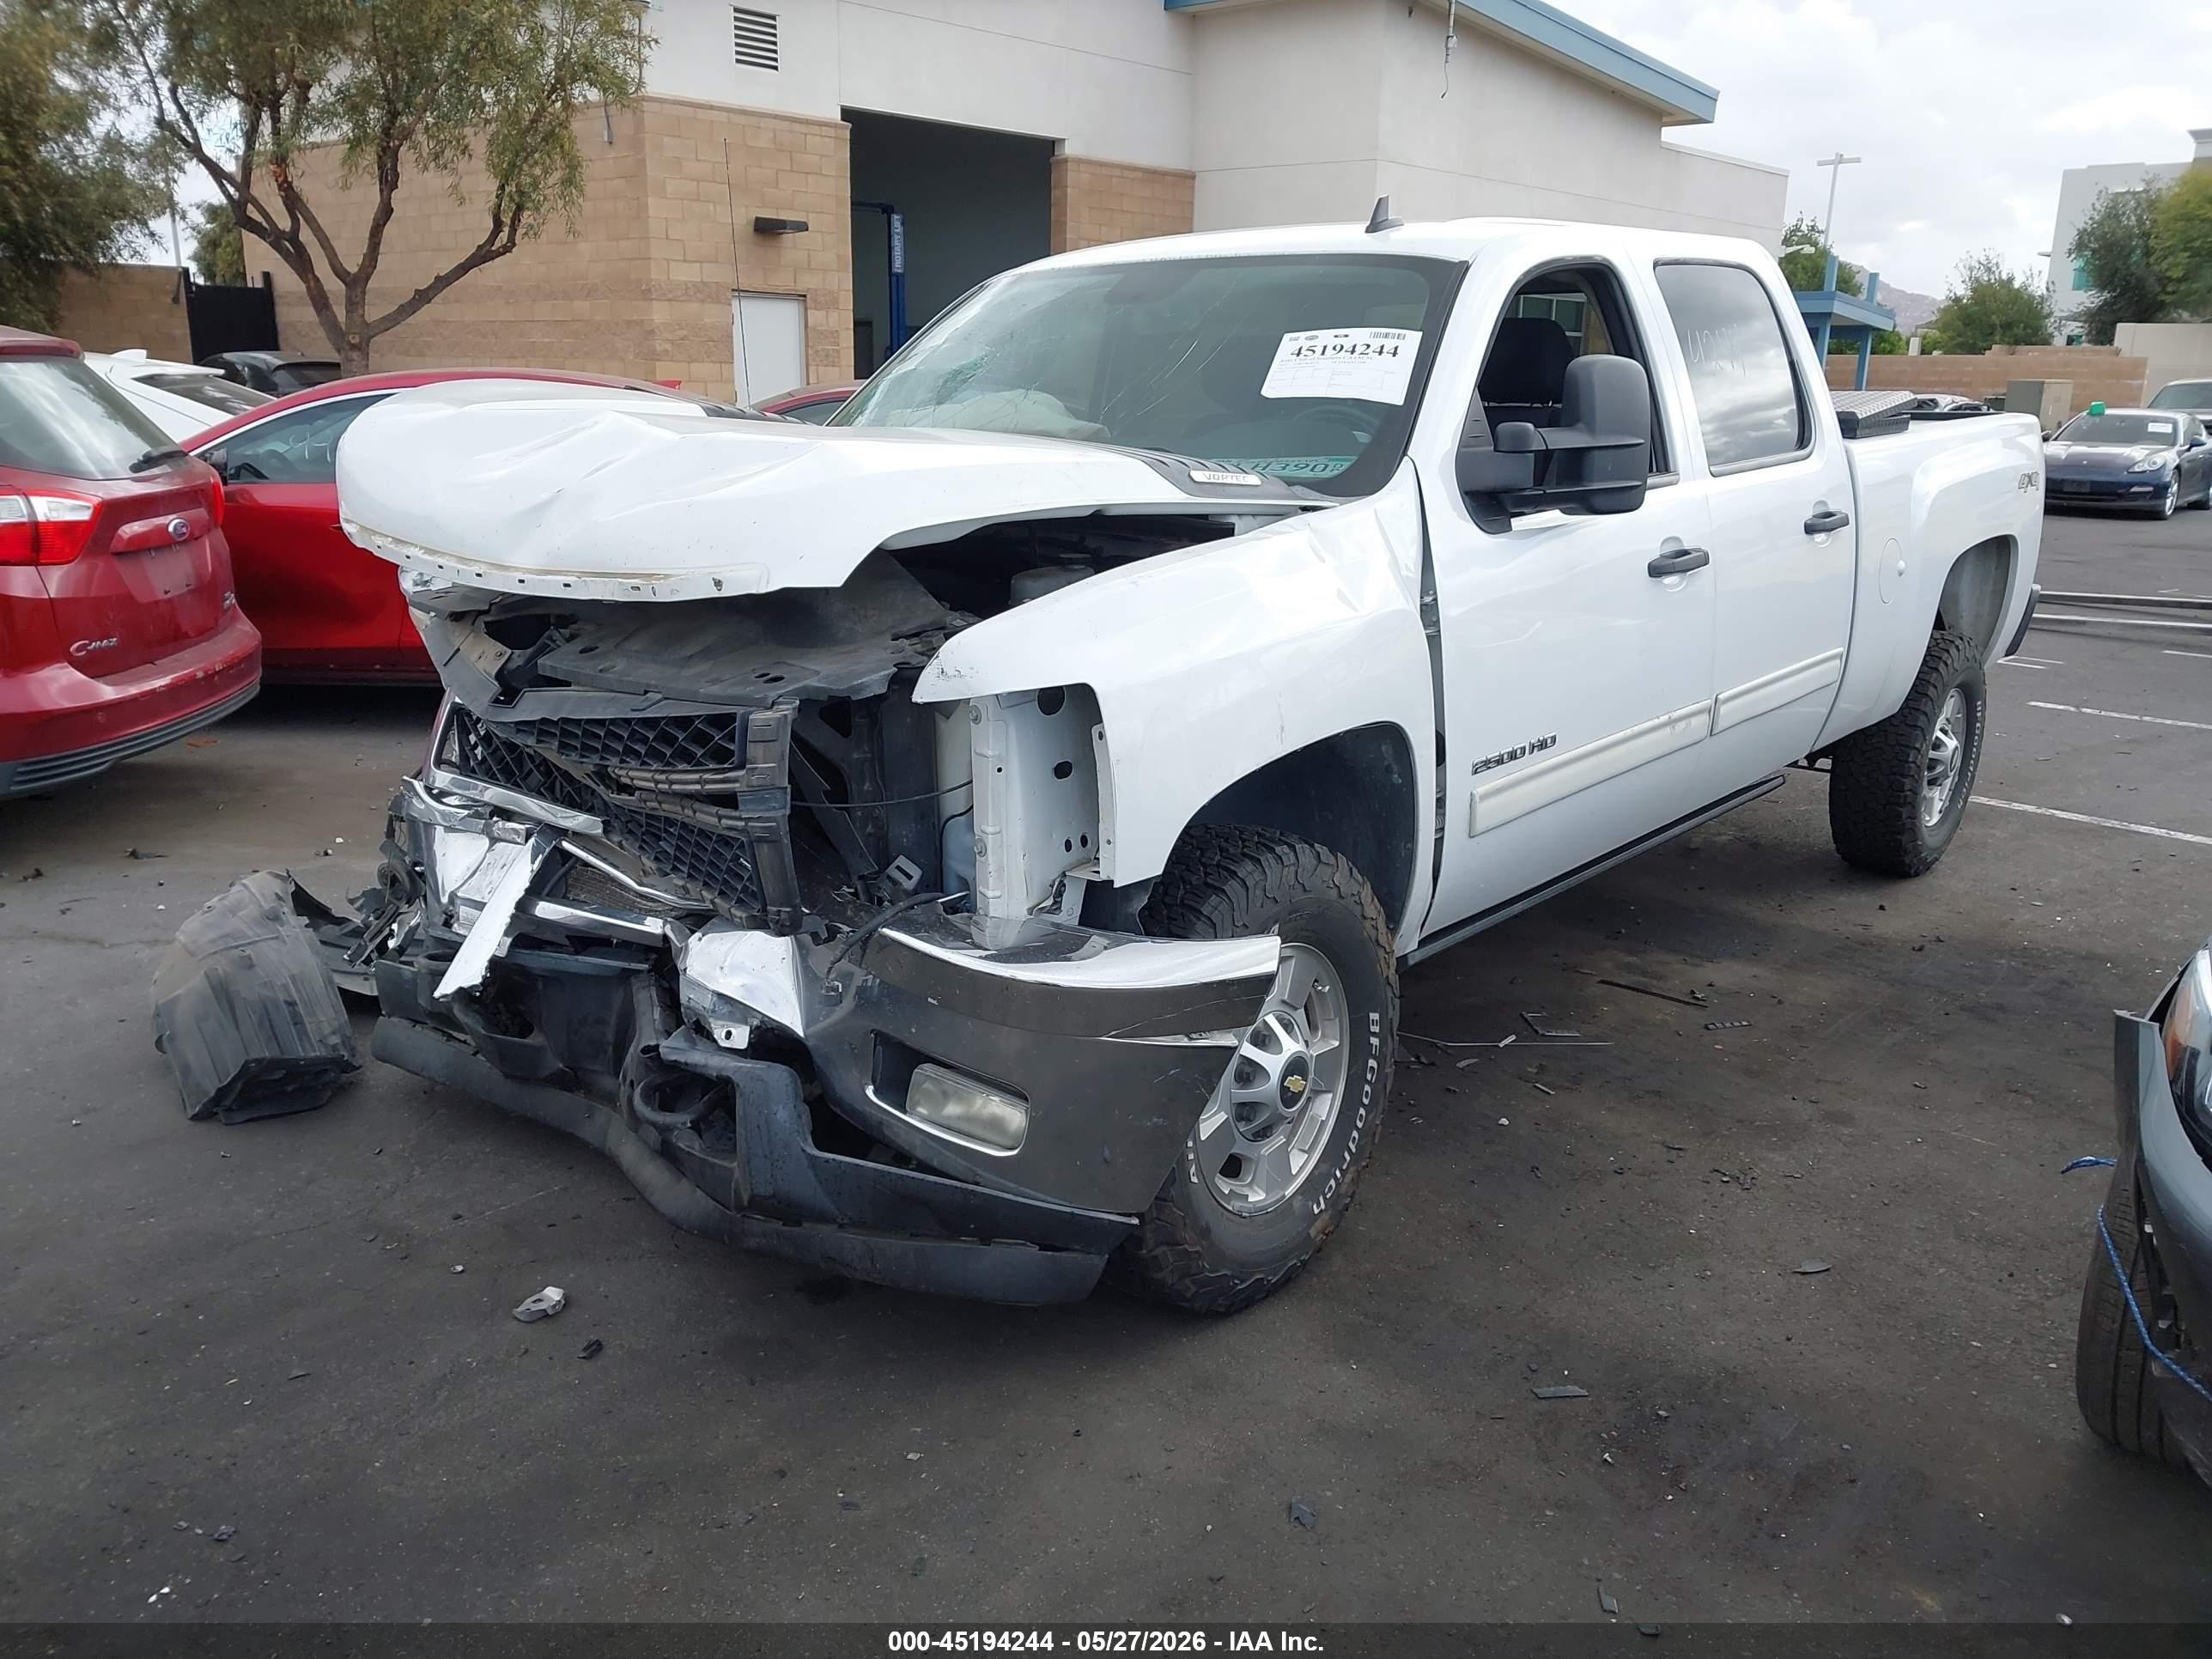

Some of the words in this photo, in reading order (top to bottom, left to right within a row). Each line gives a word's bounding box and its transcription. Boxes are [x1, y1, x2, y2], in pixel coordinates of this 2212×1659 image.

[1290, 343, 1400, 358] 45194244
[1202, 471, 1249, 483] VORTEC
[1471, 743, 1527, 776] 2500
[1528, 732, 1557, 755] HD
[1311, 1012, 1381, 1216] BFGoodrich
